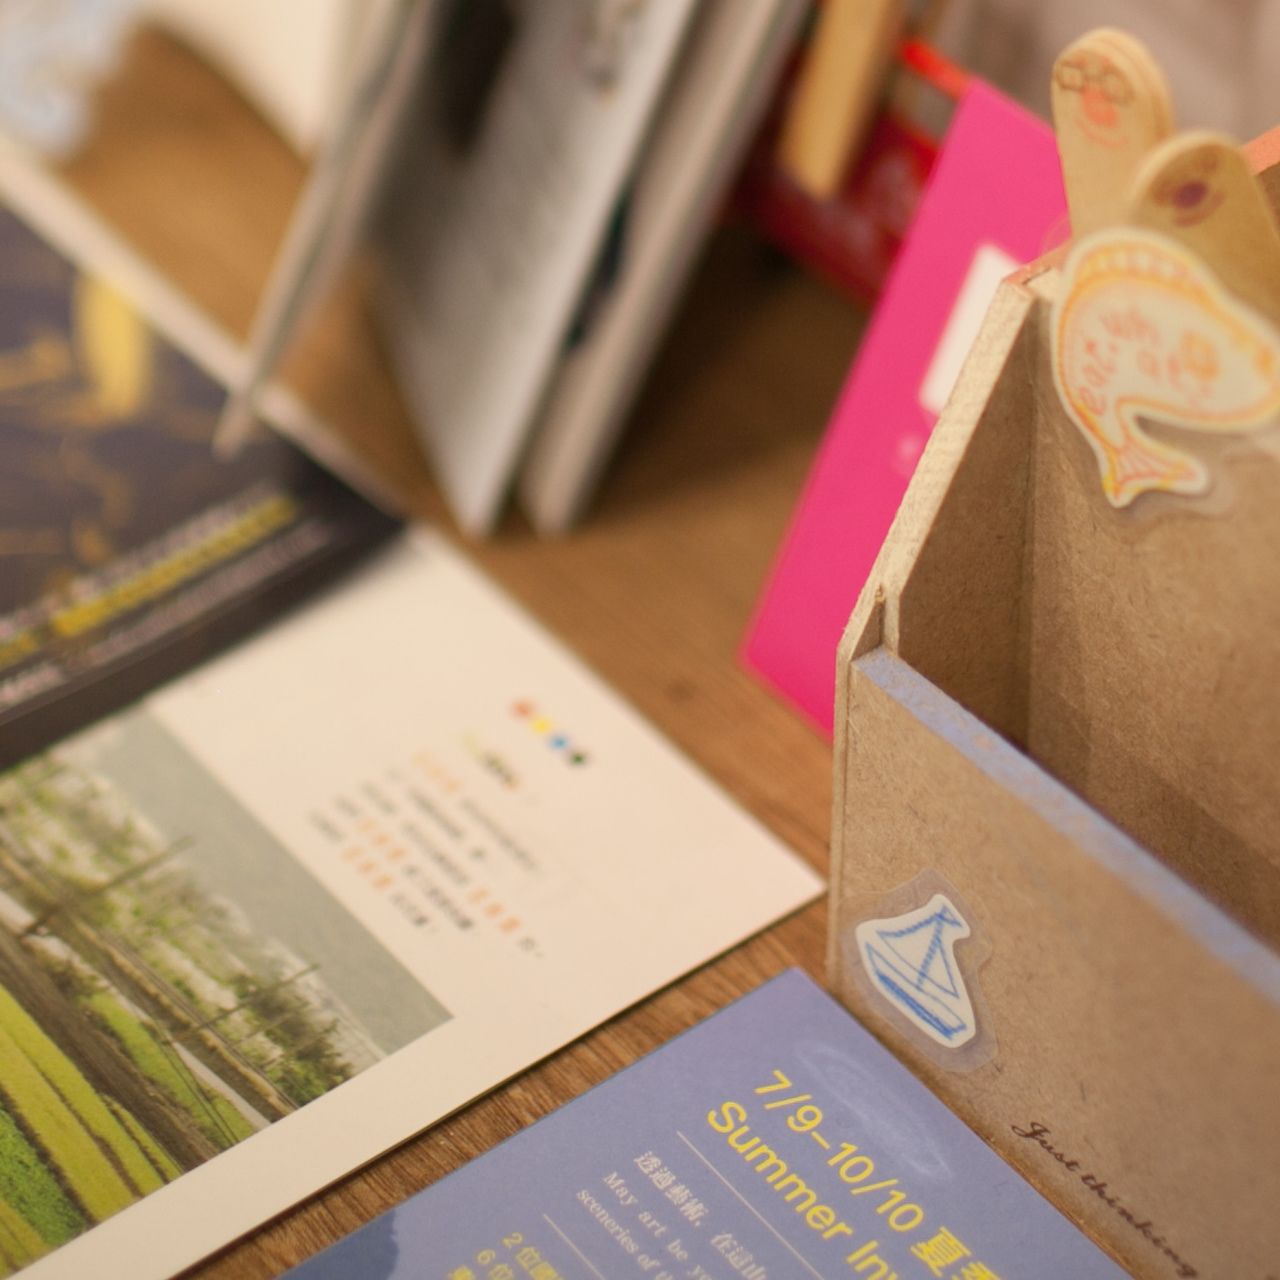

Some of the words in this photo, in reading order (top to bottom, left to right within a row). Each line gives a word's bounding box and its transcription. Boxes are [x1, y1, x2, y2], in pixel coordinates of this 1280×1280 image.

[576, 1189, 639, 1255] sceneries
[638, 1251, 661, 1271] of
[604, 1172, 638, 1207] May
[638, 1211, 669, 1238] art
[668, 1237, 689, 1261] be
[707, 1101, 853, 1239] Summer
[846, 1240, 899, 1280] In
[1011, 1120, 1080, 1172] Just
[1081, 1173, 1199, 1279] thinking
[909, 1225, 1001, 1280] 夏
